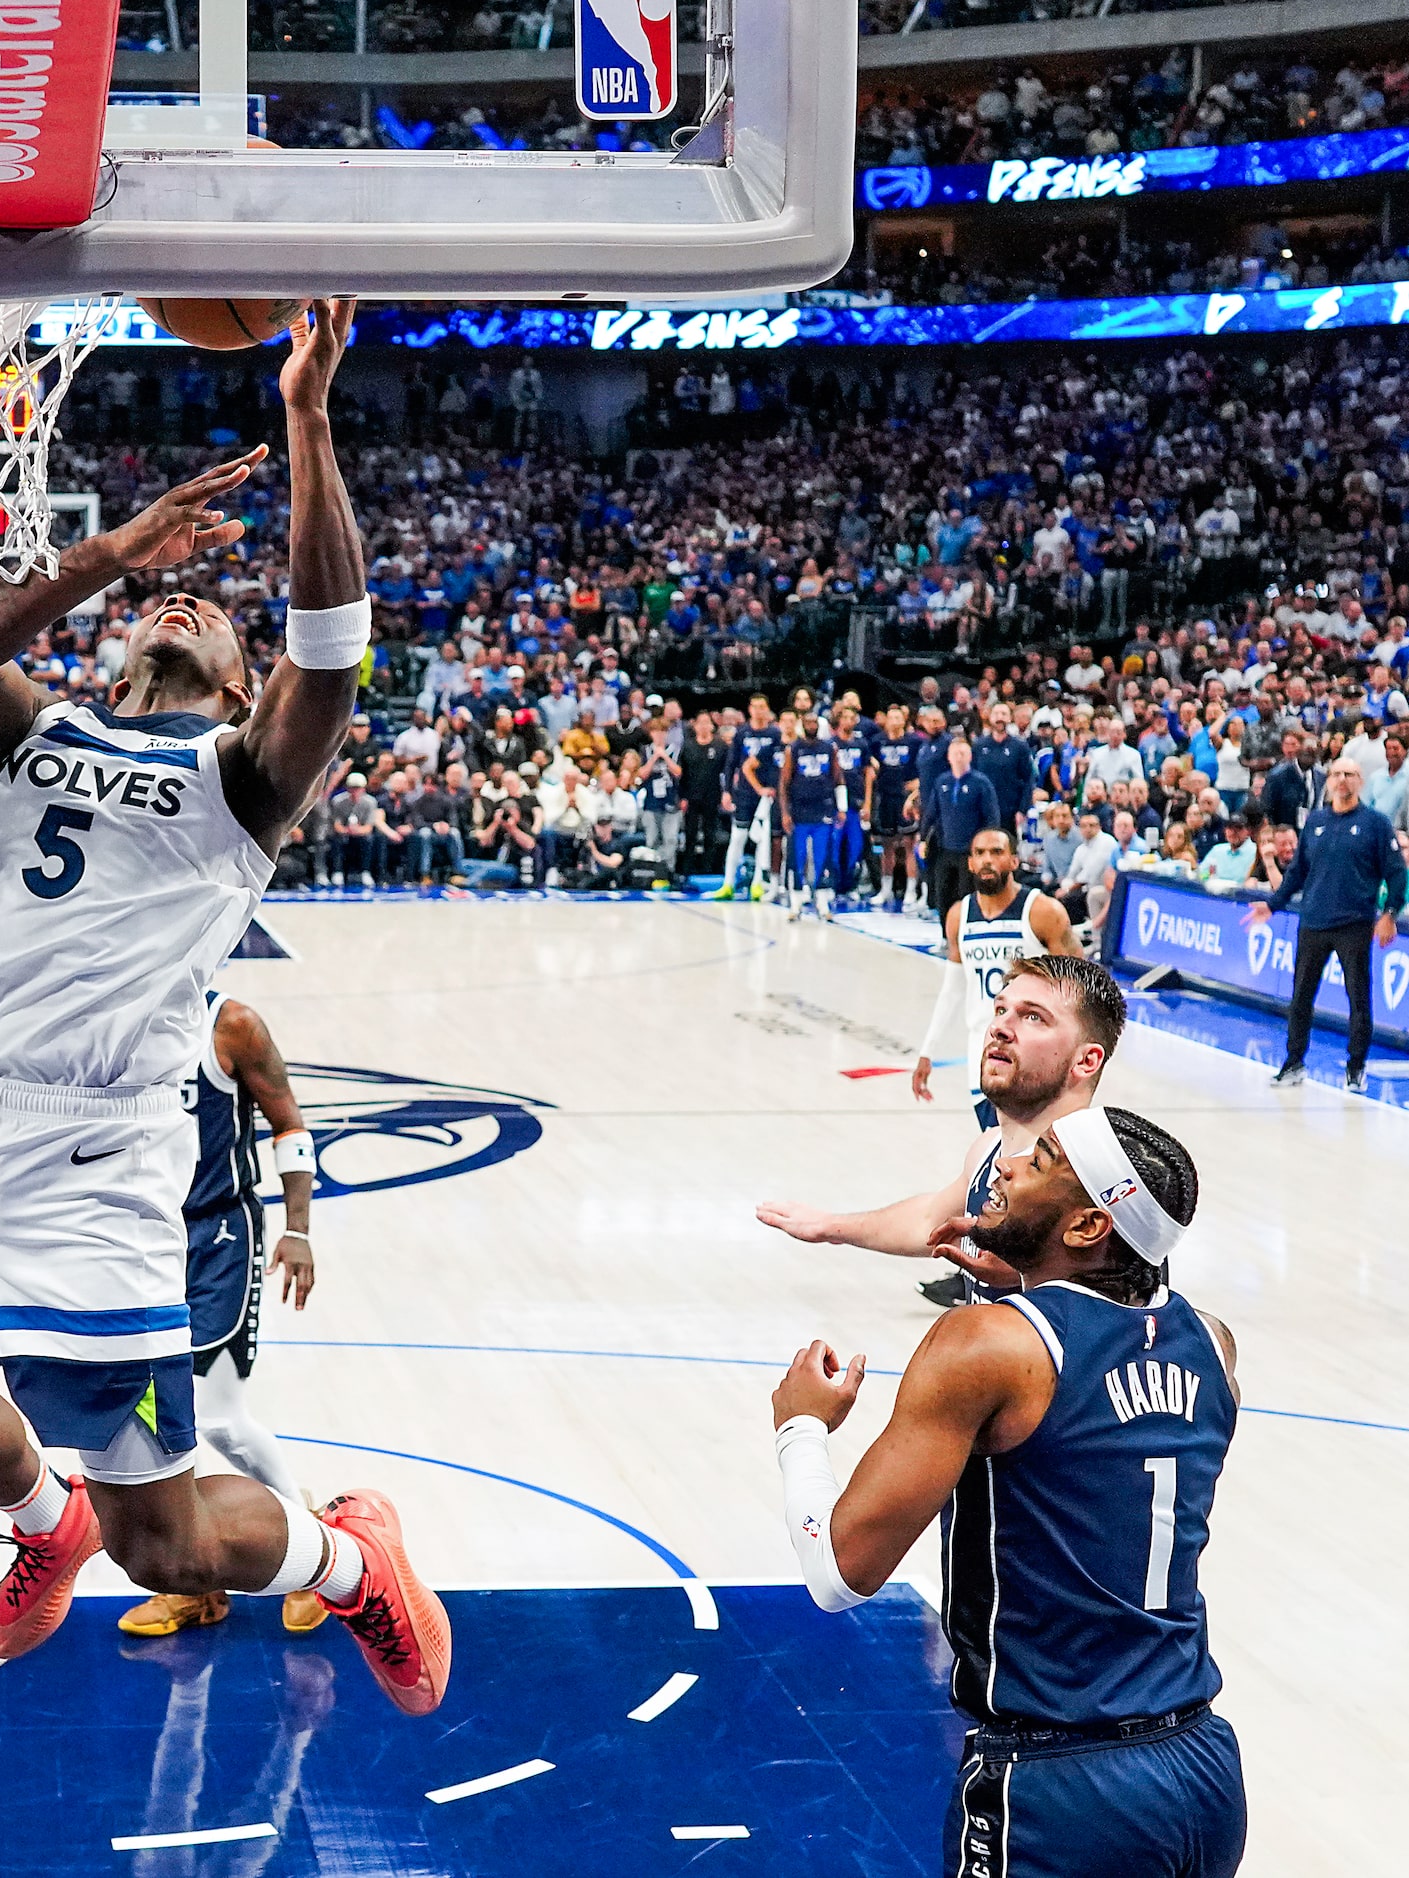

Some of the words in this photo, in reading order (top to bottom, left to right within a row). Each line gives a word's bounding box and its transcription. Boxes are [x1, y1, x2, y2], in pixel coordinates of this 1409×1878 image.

[592, 67, 639, 104] NBA
[22, 804, 95, 899] 5
[965, 945, 1024, 960] WOLVES
[1157, 913, 1223, 956] FANDUEL
[1104, 1360, 1201, 1424] HARDY
[1144, 1456, 1177, 1611] 1
